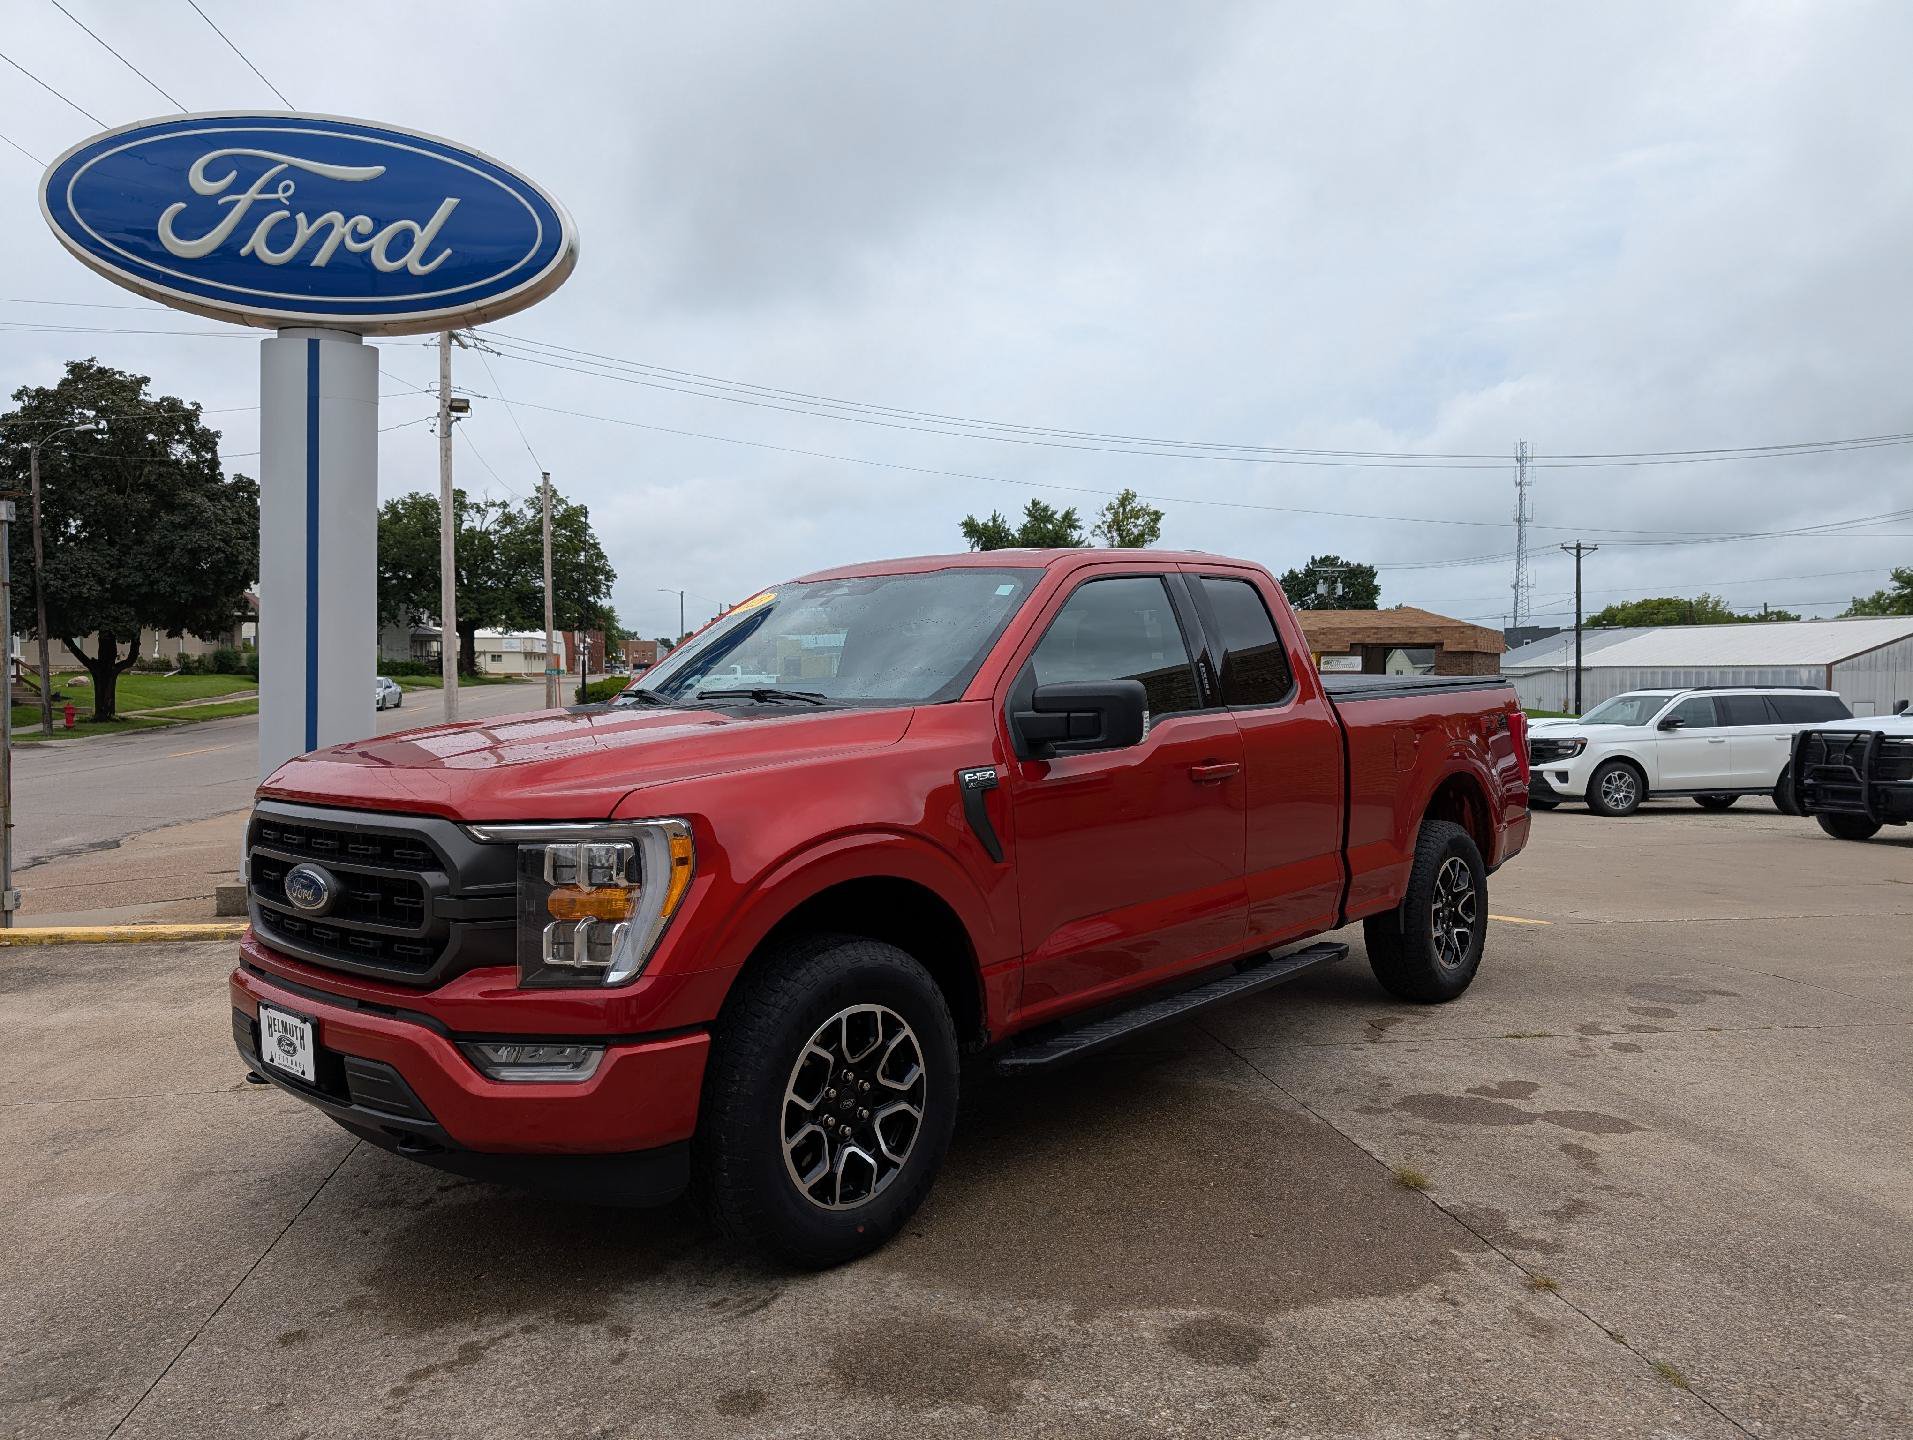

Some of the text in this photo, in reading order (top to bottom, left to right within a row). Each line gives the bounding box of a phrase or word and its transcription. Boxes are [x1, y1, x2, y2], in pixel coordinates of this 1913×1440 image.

[158, 148, 460, 276] Ford
[965, 771, 995, 782] F-150
[292, 877, 316, 900] Ford
[267, 1014, 306, 1051] HELMUTH
